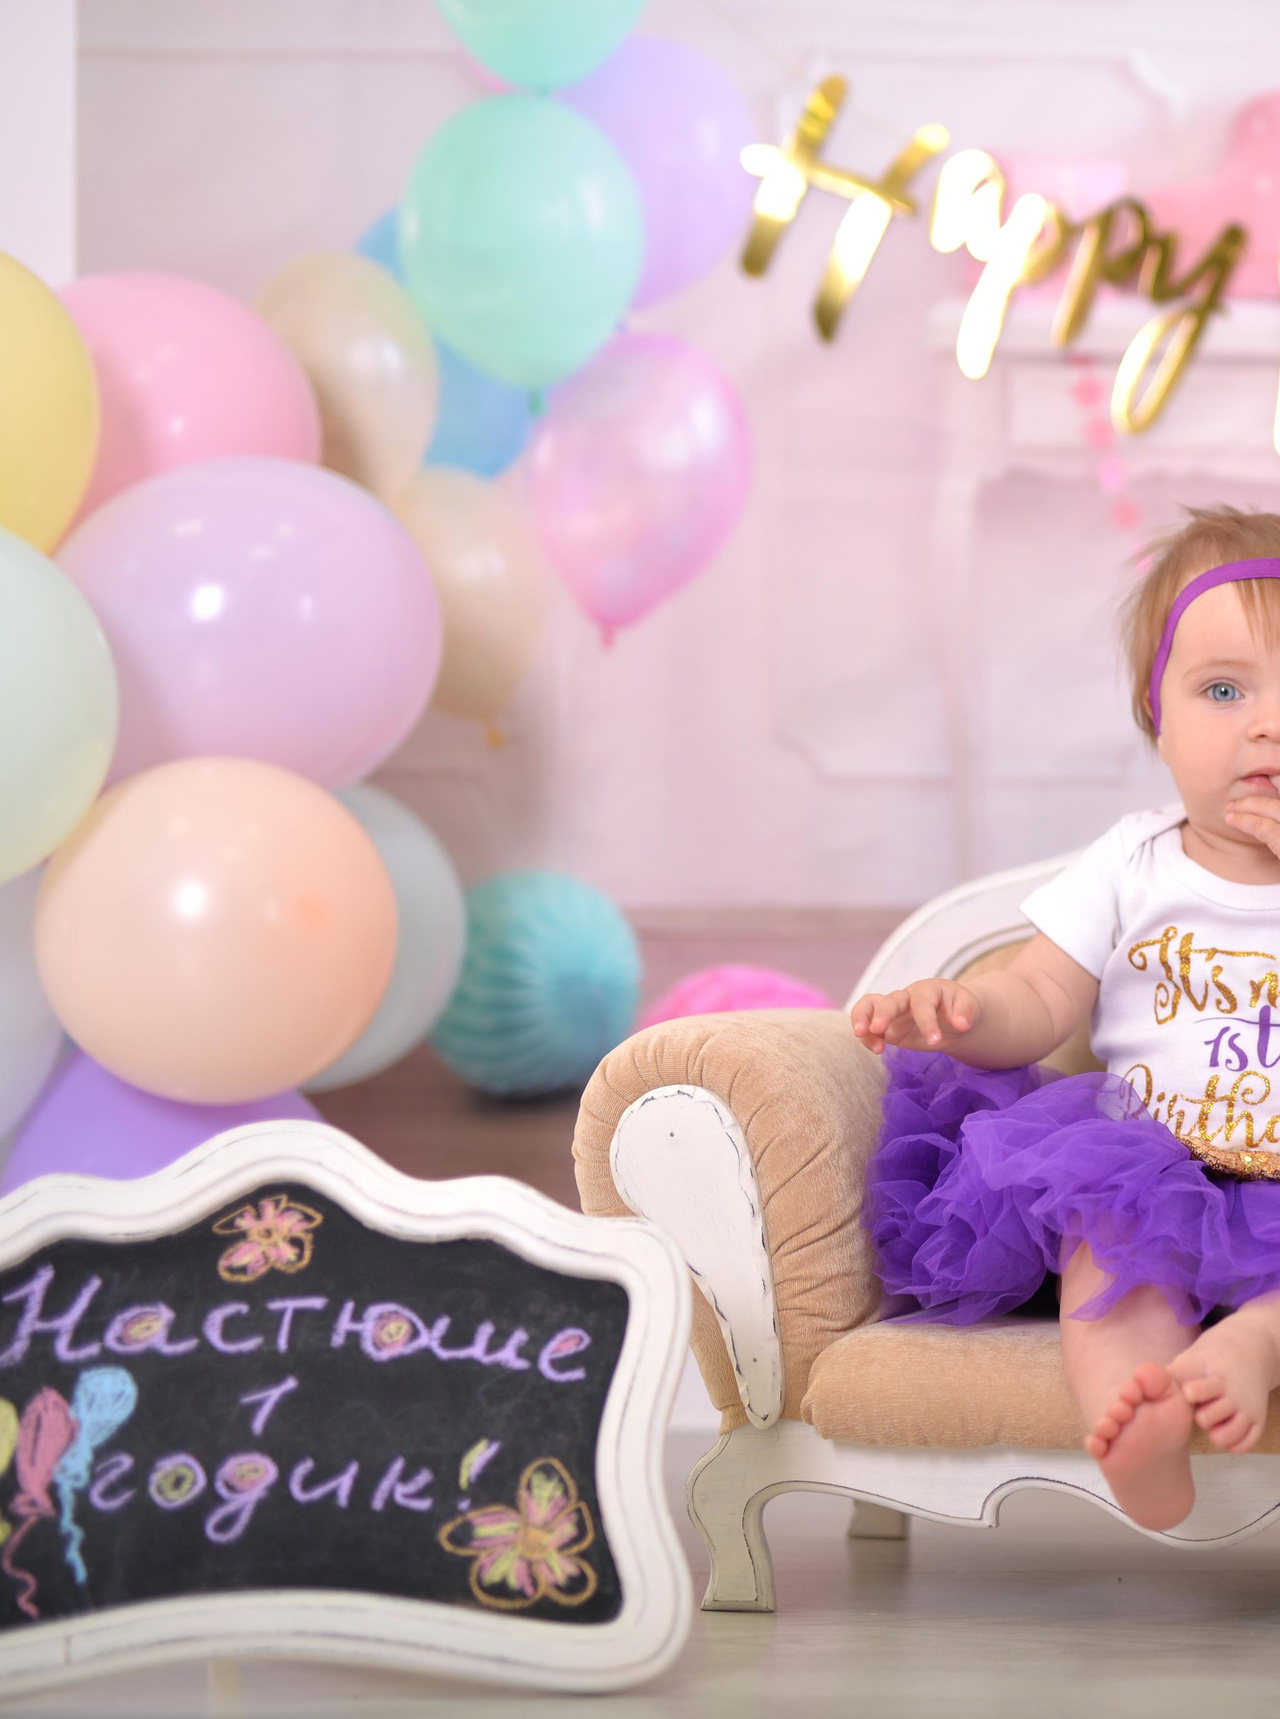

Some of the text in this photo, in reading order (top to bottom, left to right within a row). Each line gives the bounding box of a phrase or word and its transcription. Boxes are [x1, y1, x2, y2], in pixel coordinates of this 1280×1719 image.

[740, 74, 1248, 435] Happy
[0, 1263, 591, 1382] Настюше
[239, 1376, 299, 1436] 1
[89, 1438, 500, 1544] годик!
